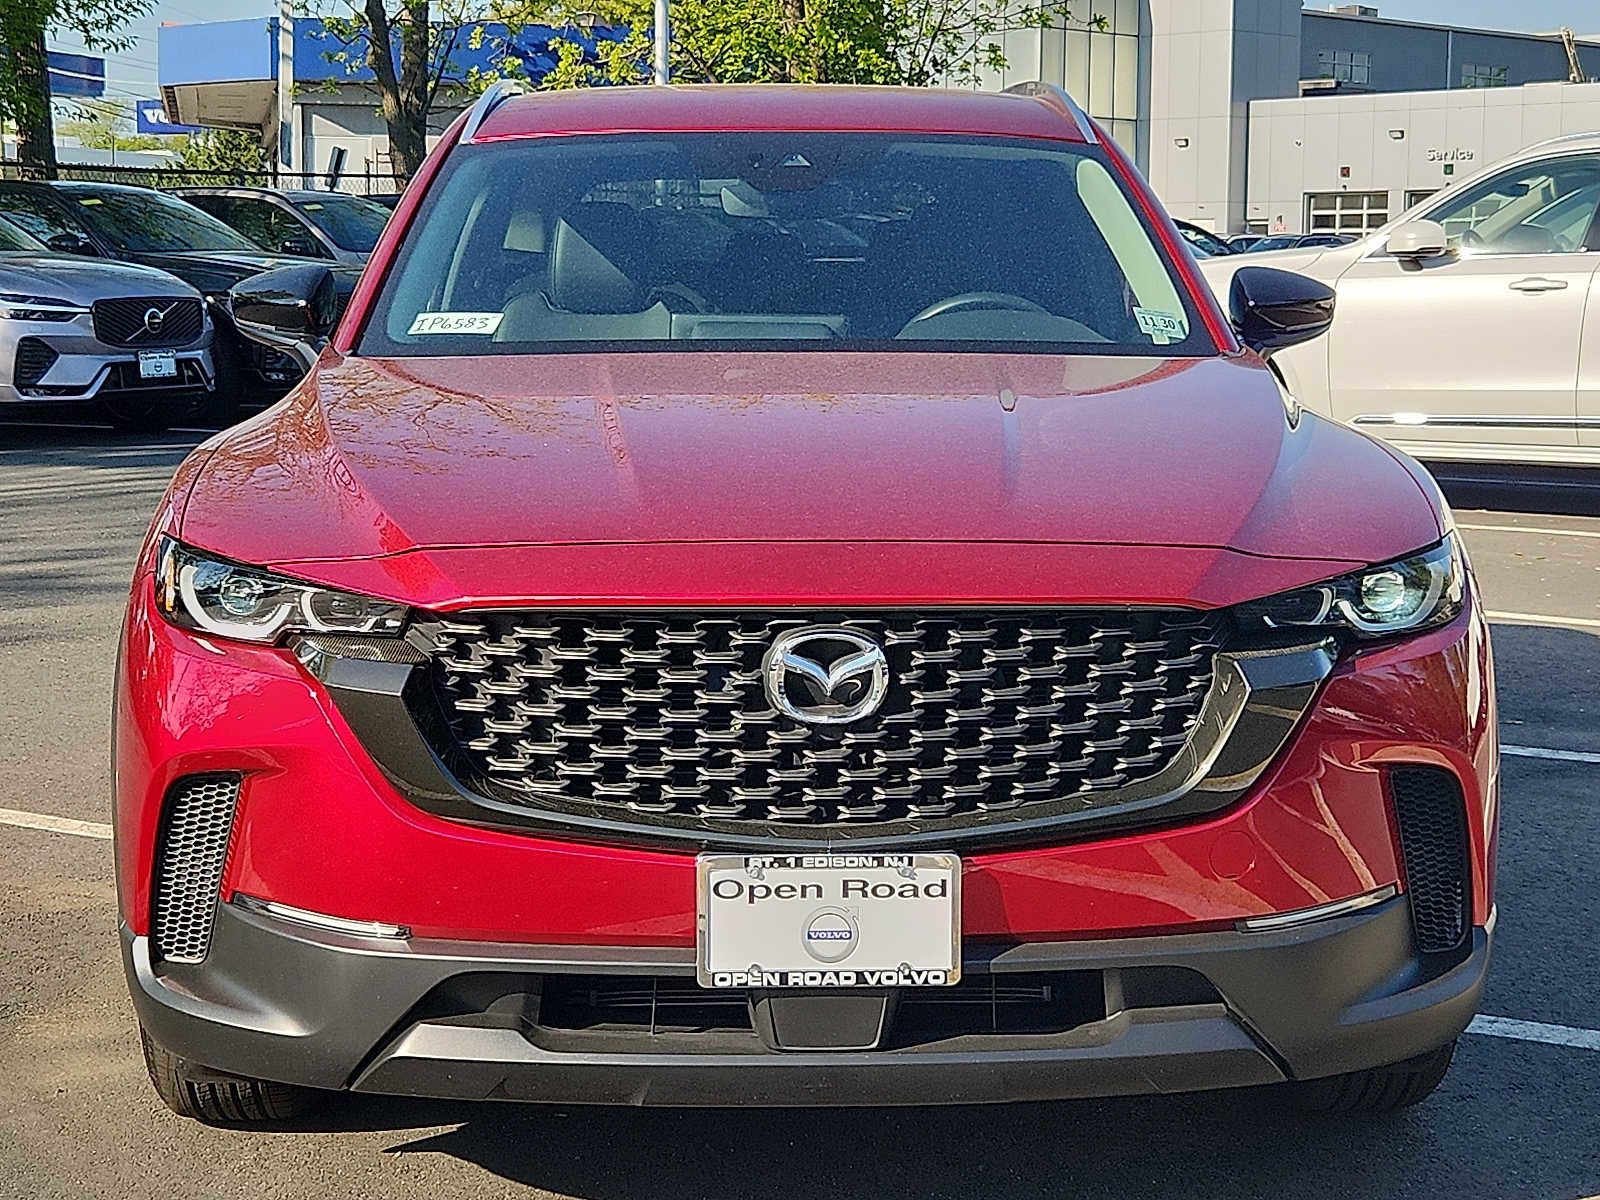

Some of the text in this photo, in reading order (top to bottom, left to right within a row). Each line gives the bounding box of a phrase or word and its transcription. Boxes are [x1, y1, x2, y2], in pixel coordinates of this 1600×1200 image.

[1427, 148, 1474, 161] Service
[786, 856, 796, 868] 1
[884, 856, 909, 868] NJ
[713, 879, 947, 904] Open Road
[808, 931, 851, 939] VOLVO
[714, 970, 946, 987] OPEN ROAD VOLVO
